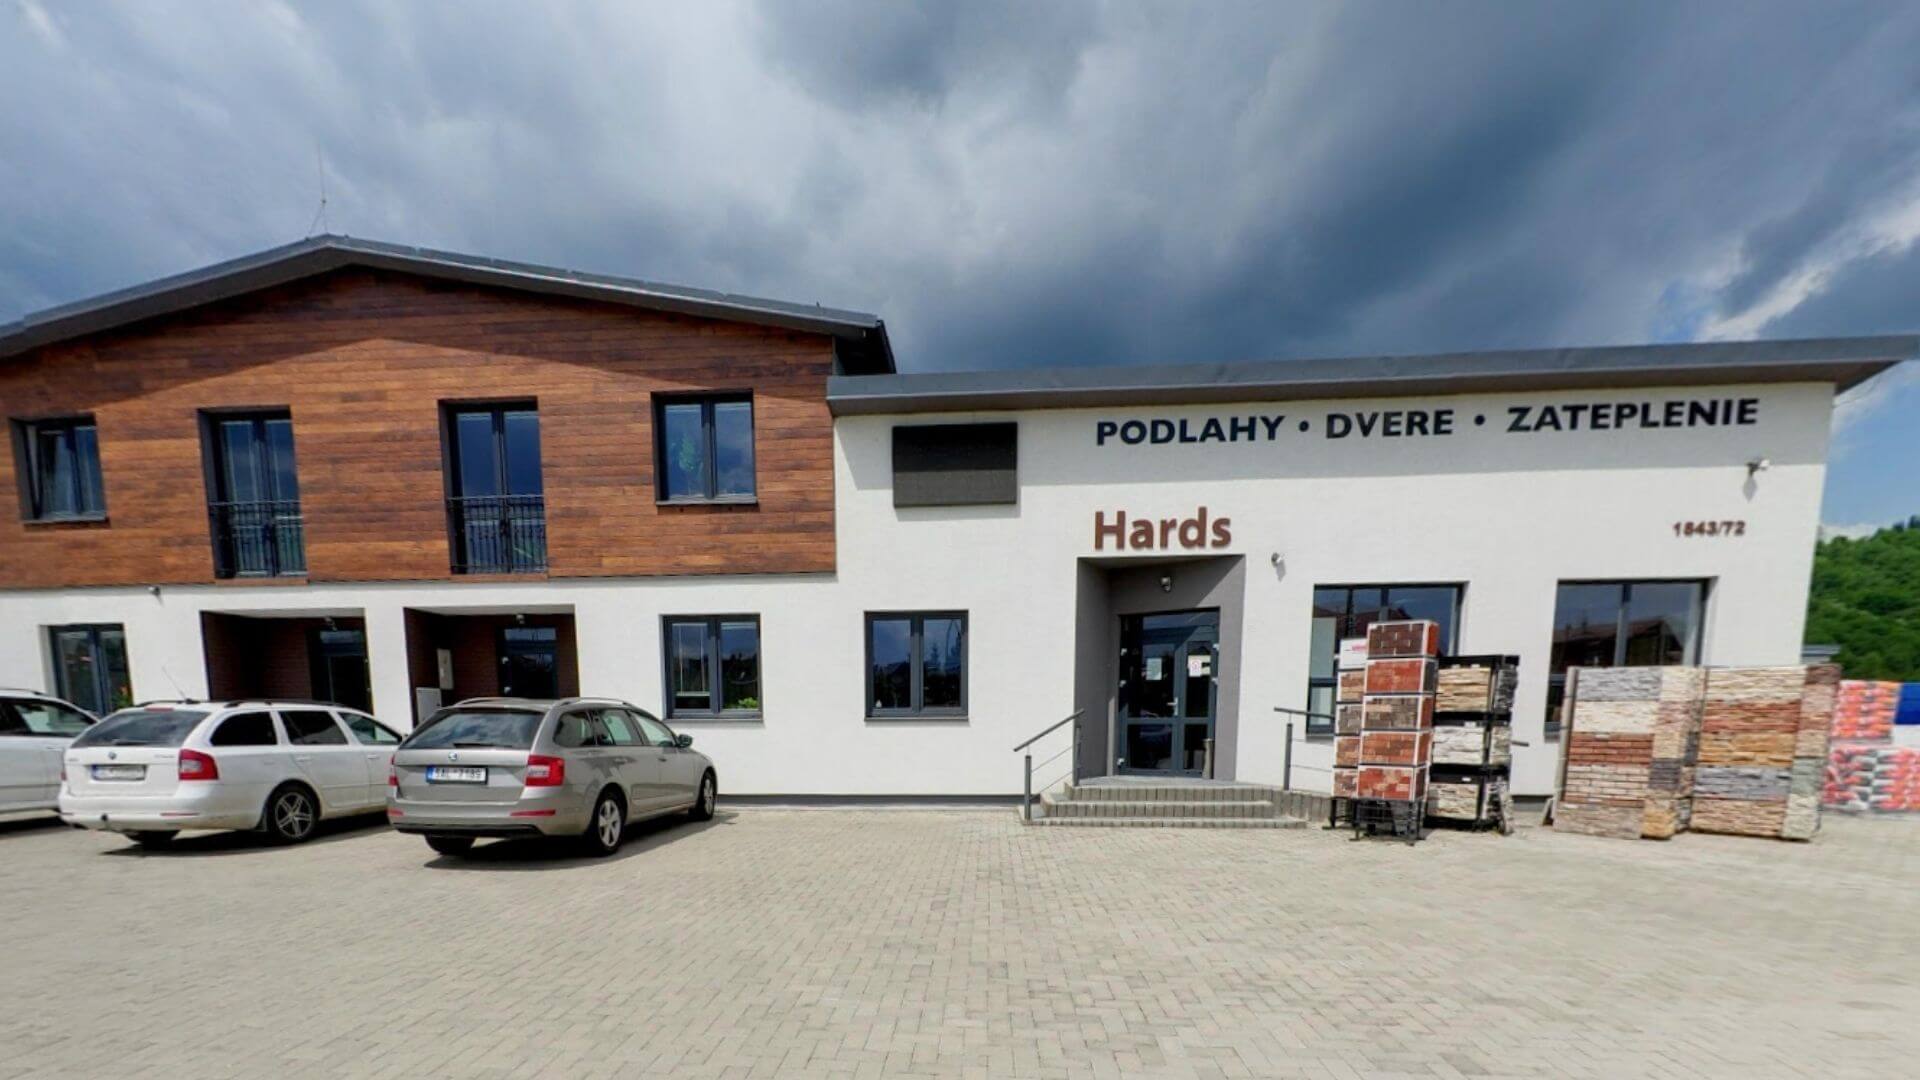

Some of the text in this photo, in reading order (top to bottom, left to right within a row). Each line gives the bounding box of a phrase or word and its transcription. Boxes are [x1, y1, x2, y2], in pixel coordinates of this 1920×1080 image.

[1096, 398, 1759, 446] PODLAHY DVERE ZATEPLENIE
[1094, 507, 1231, 551] Hards
[1673, 520, 1746, 537] 1843/72
